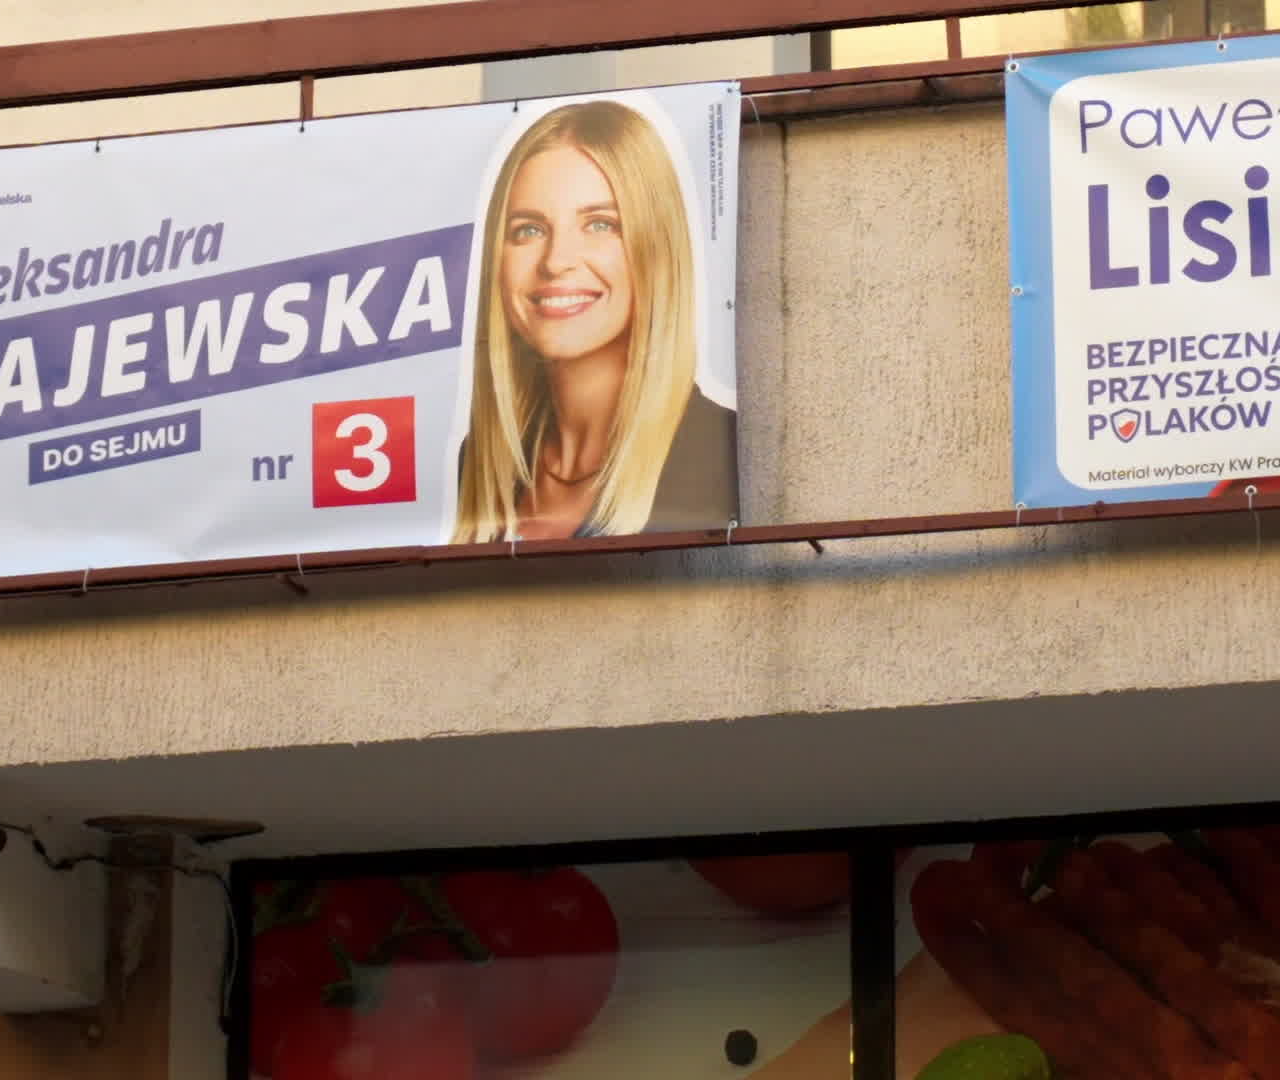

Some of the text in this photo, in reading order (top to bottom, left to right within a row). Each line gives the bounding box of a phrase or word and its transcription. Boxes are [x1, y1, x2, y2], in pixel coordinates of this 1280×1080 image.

[42, 423, 187, 472] DO SEJMU
[251, 412, 391, 492] nr 3
[1154, 460, 1225, 478] wyborczy
[1228, 457, 1253, 472] KW
